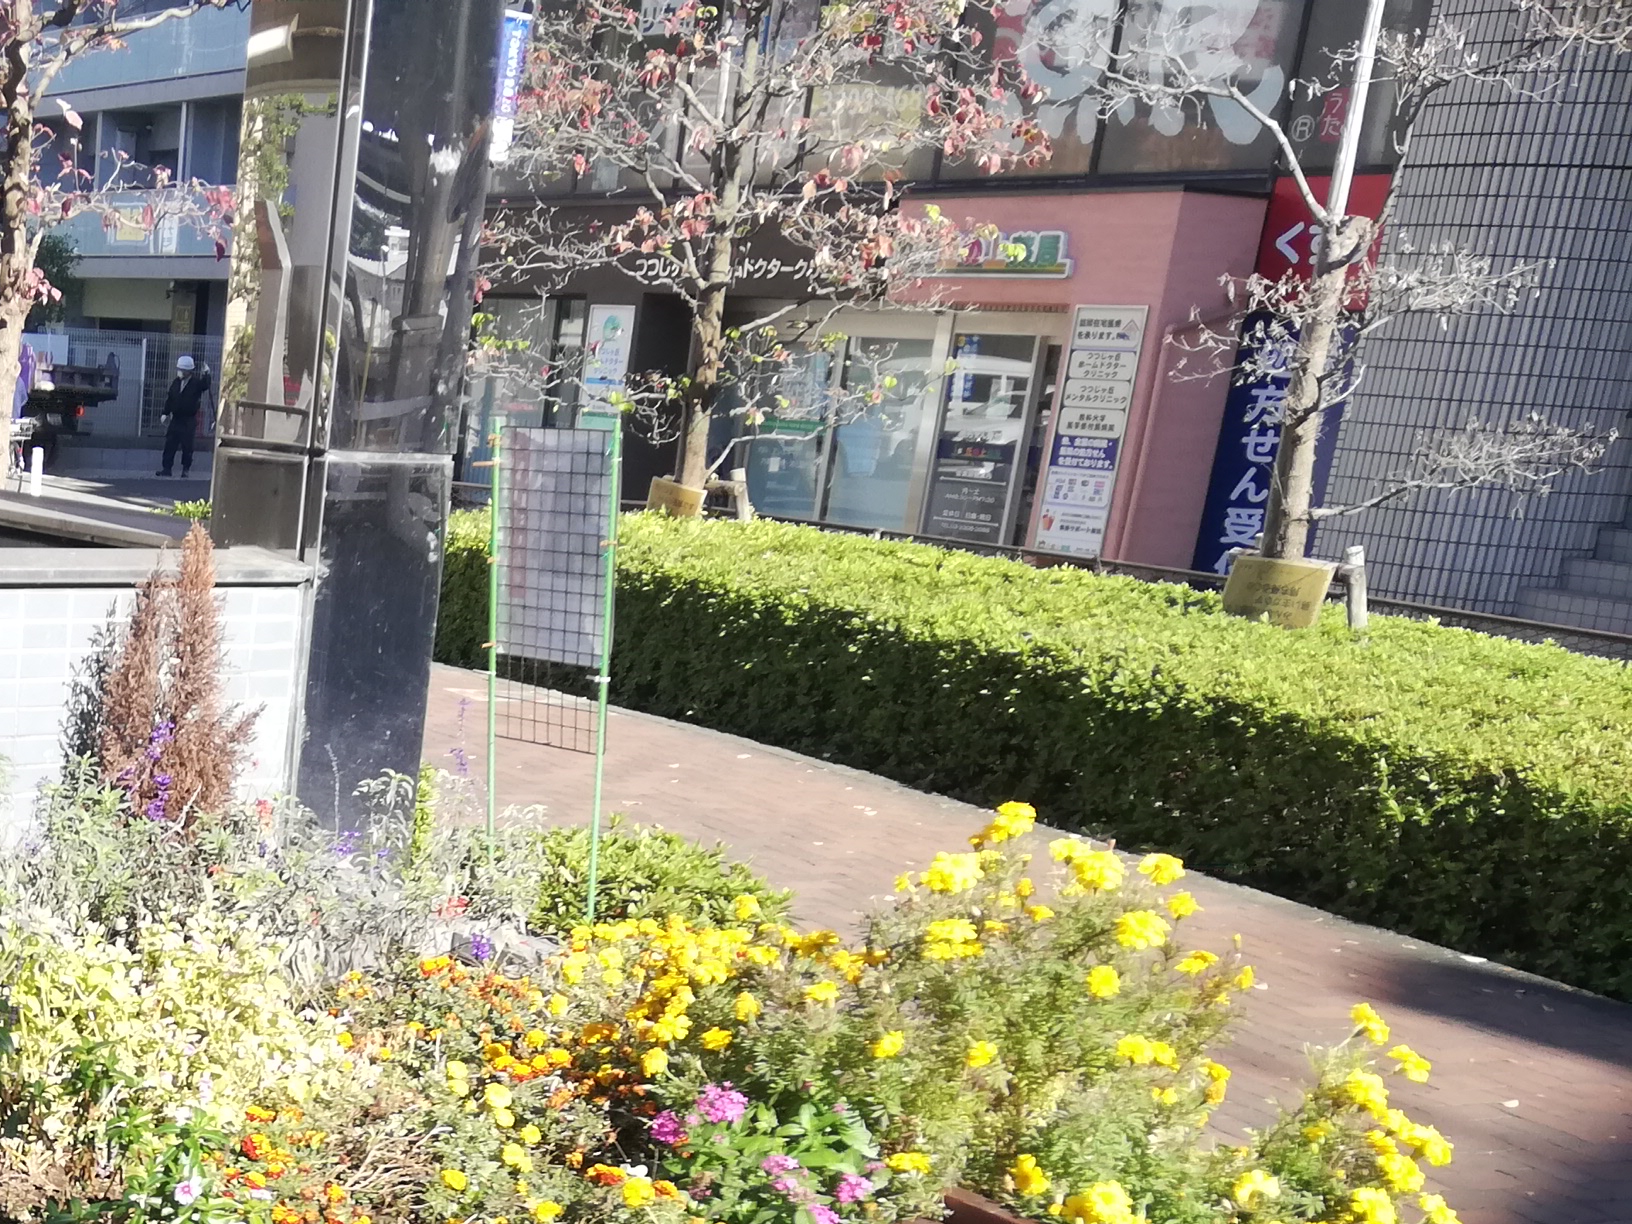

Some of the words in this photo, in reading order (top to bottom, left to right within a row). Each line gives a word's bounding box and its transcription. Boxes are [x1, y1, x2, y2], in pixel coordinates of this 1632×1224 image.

[1077, 361, 1127, 370] ホームドクター
[1083, 370, 1118, 379] クリニック
[1065, 394, 1128, 404] メンタルクリニック
